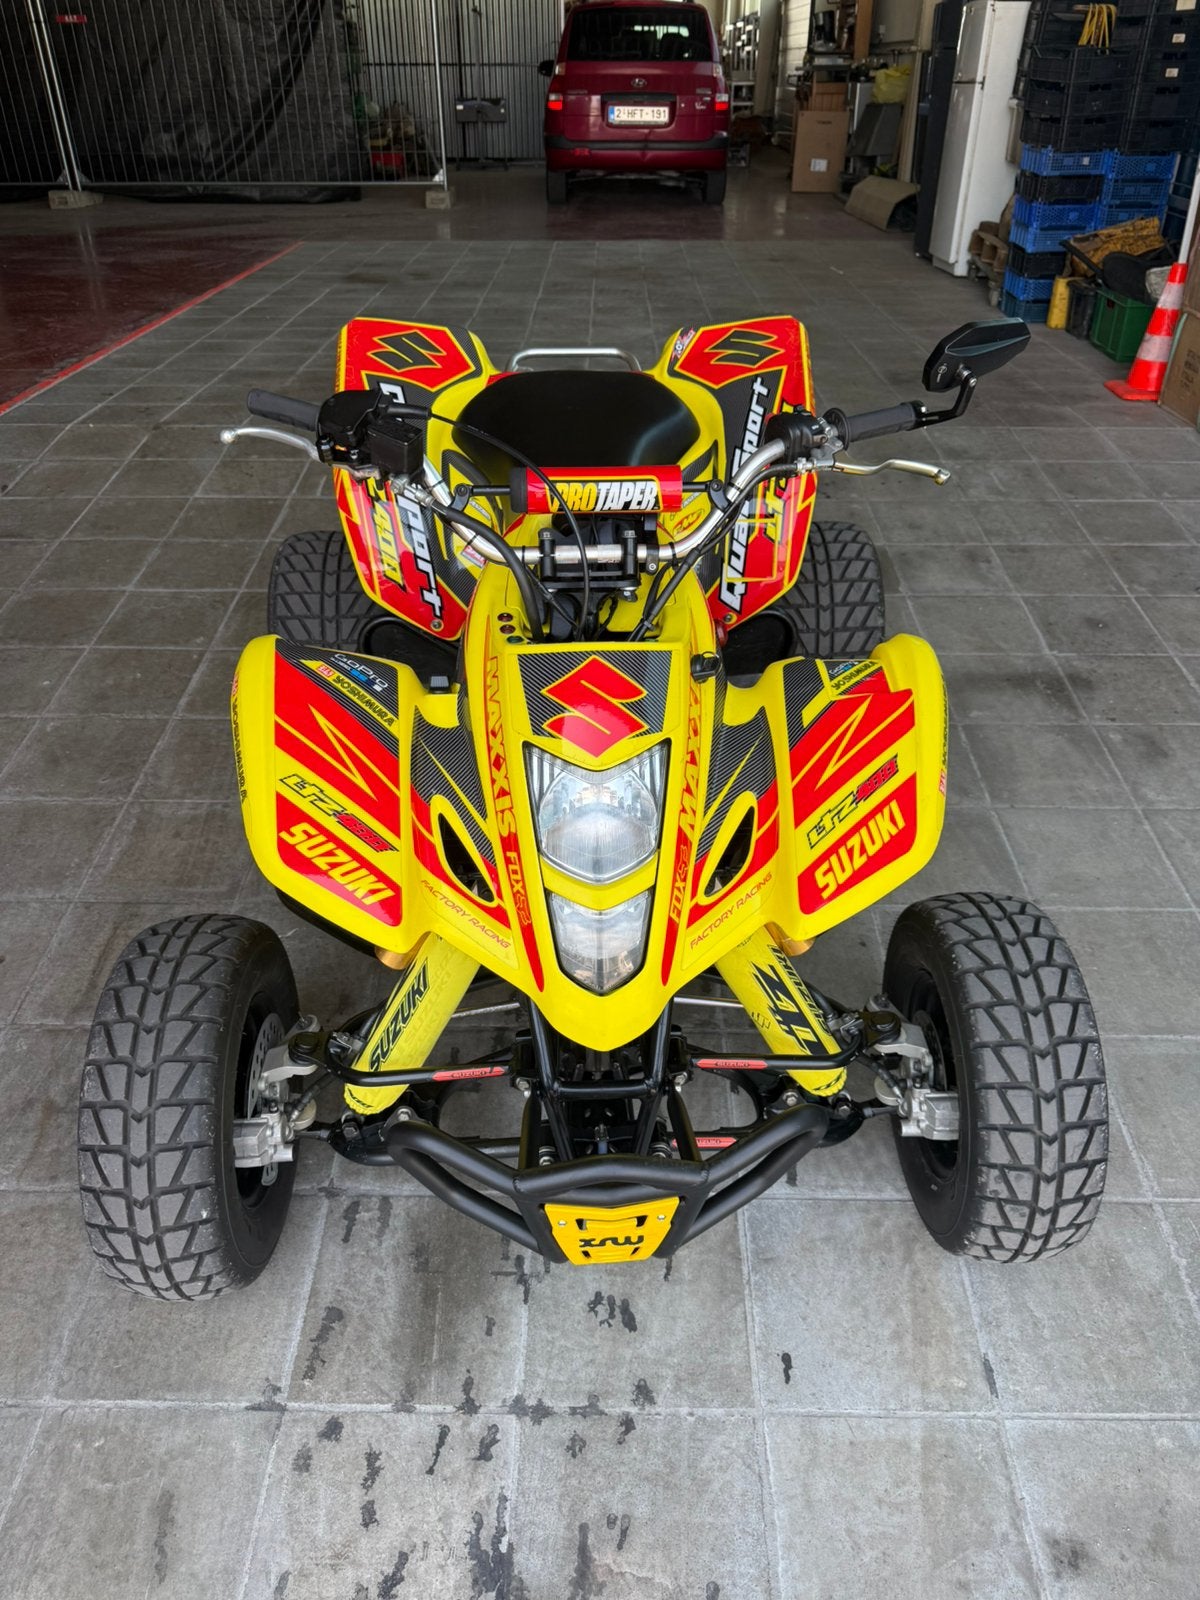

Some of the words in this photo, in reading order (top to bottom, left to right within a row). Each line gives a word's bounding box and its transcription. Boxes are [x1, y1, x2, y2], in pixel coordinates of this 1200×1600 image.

[487, 656, 520, 838] MAXXIS
[278, 822, 396, 906] SUZUKI
[814, 799, 906, 900] SUZUKI
[421, 880, 471, 917] FACTORY
[468, 917, 511, 949] RACING
[690, 905, 735, 950] FACTORY
[736, 872, 773, 910] RACING
[370, 959, 429, 1072] SUZUKI
